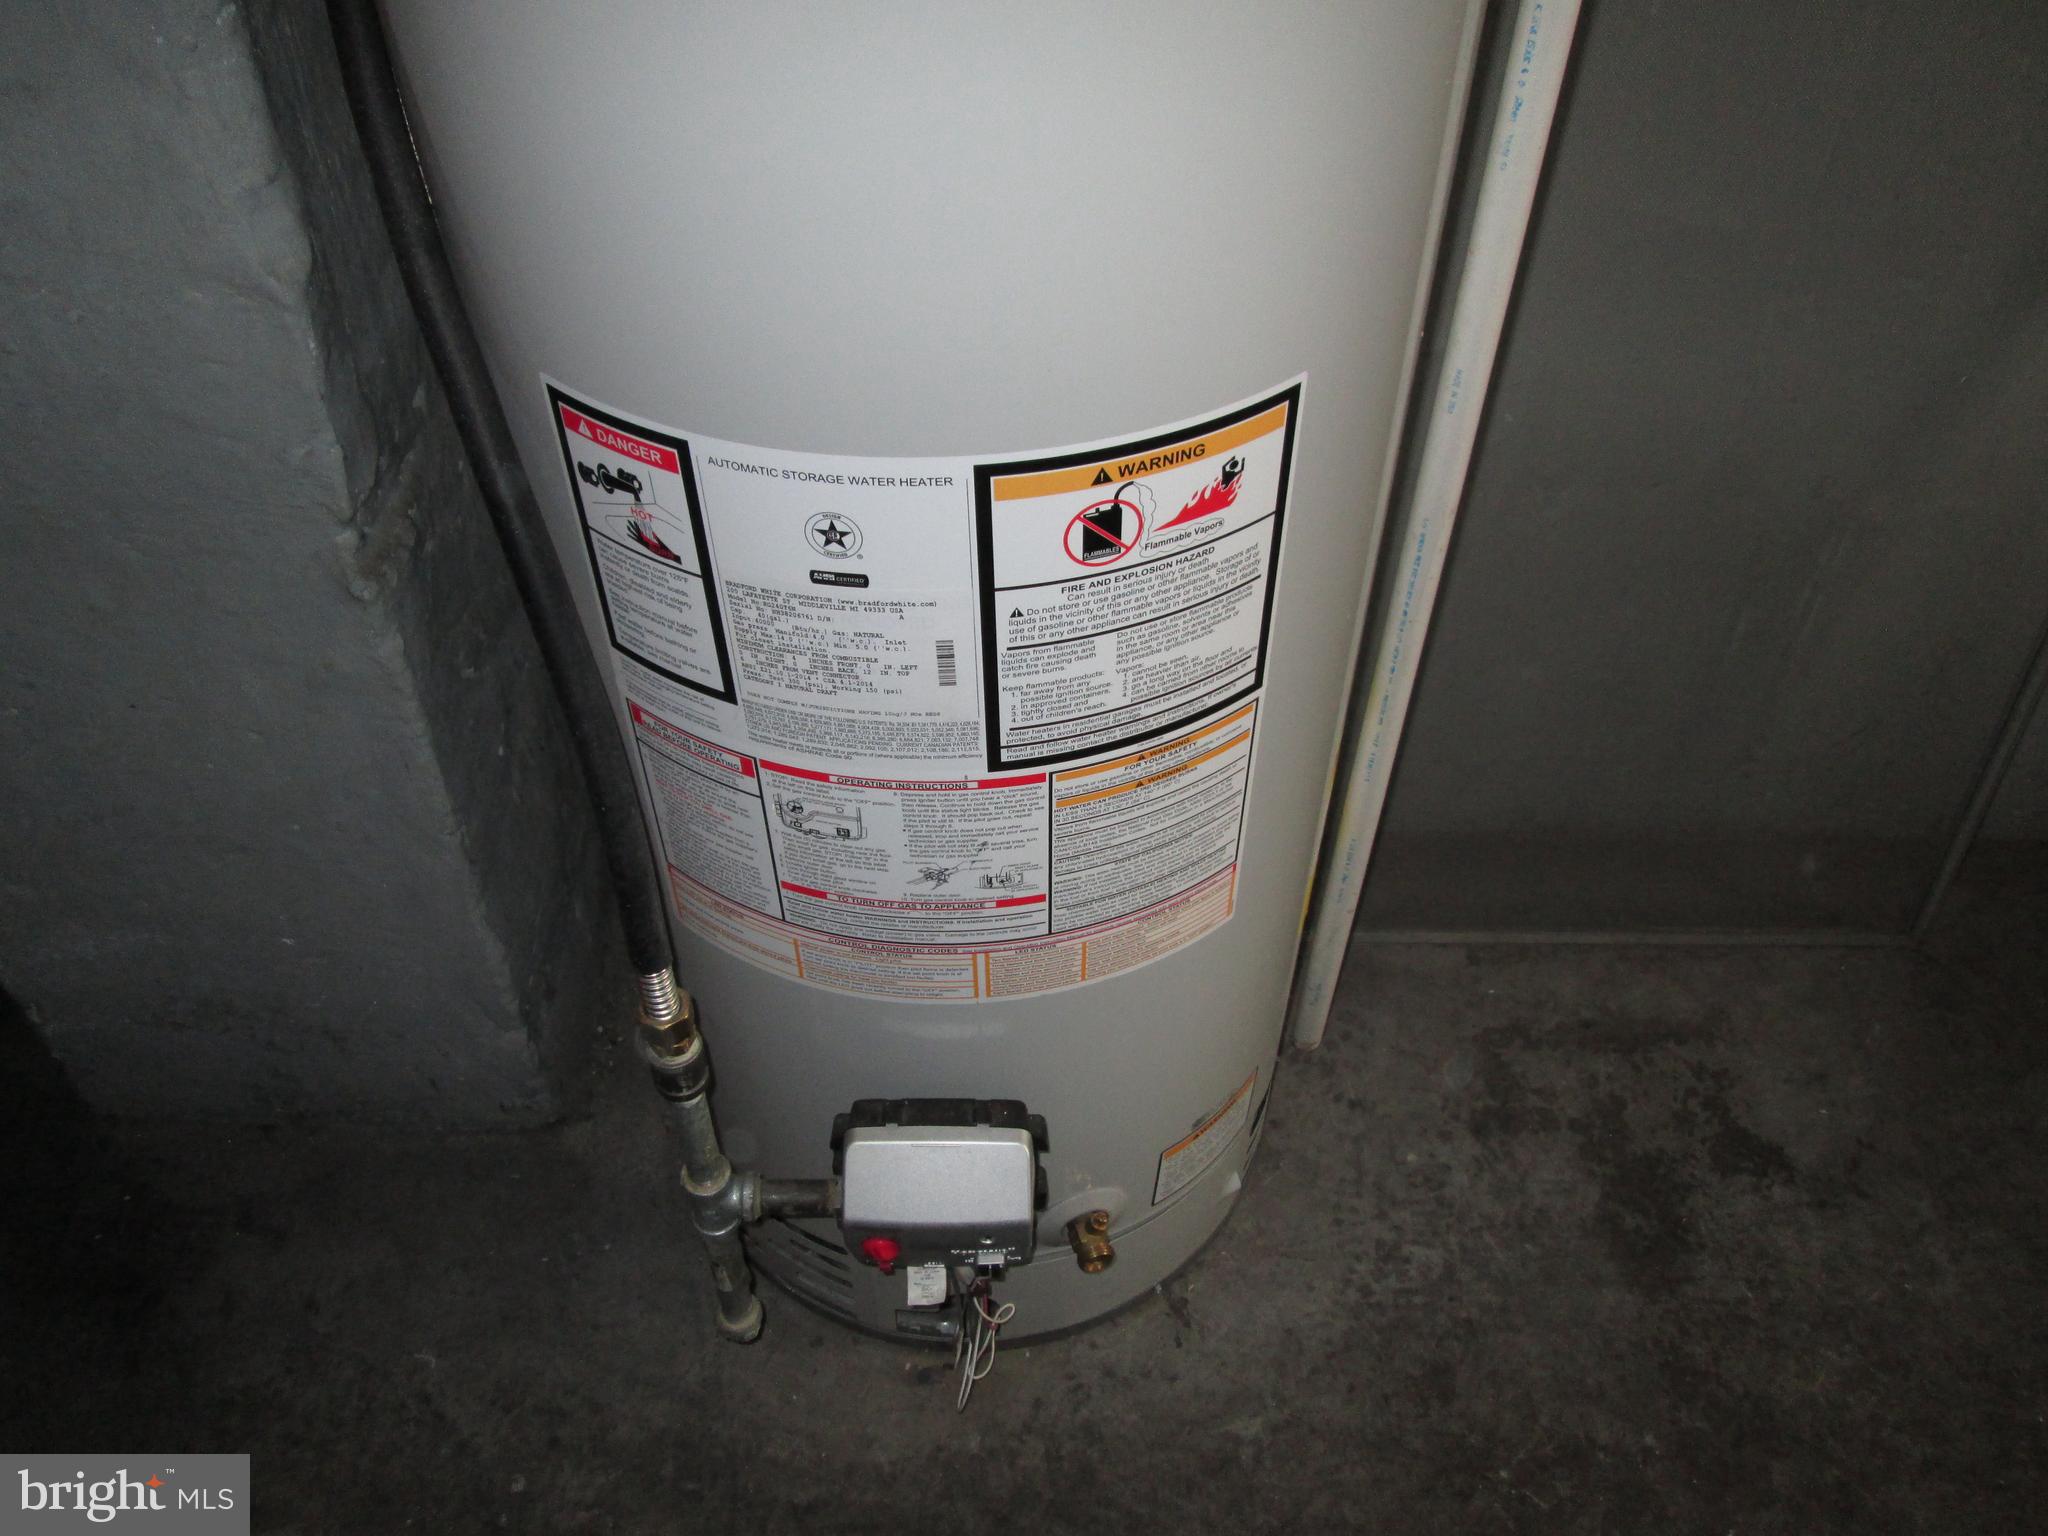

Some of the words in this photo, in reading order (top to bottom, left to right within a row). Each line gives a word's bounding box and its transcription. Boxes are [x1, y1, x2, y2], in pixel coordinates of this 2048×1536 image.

[596, 430, 662, 464] DANGER
[708, 456, 778, 478] AUTOMATIC
[782, 470, 844, 485] STORAGE
[847, 476, 896, 487] WATER
[900, 477, 953, 487] HEATER
[1118, 443, 1206, 478] WARNING
[1144, 530, 1191, 551] Flammable
[1193, 519, 1223, 534] Vapors
[1061, 585, 1085, 594] FIRE
[1088, 579, 1111, 588] AND
[1114, 561, 1174, 583] EXPLOSION
[1176, 547, 1215, 565] HAZARD
[726, 581, 756, 592] BRADFORD
[760, 588, 781, 596] WHITE
[786, 592, 832, 603] CORPORATION
[1041, 606, 1056, 614] not
[1058, 602, 1079, 611] store
[1111, 589, 1144, 602] gasoline
[1158, 577, 1179, 587] other
[1180, 561, 1218, 581] flammable
[1067, 593, 1085, 601] Can
[1087, 588, 1111, 598] result
[1123, 576, 1152, 590] serious
[1154, 569, 1175, 583] injury
[1009, 616, 1036, 627] liquids
[1049, 612, 1063, 620] the
[1066, 605, 1093, 619] vicinity
[1107, 600, 1121, 609] this
[1134, 596, 1149, 605] any
[1151, 588, 1171, 599] other
[1038, 620, 1073, 634] gasoline
[1087, 612, 1108, 623] other
[1112, 600, 1154, 617] flammable
[1156, 592, 1181, 605] vapors
[1193, 579, 1216, 592] liquids
[1020, 633, 1035, 642] this
[1049, 630, 1064, 639] any
[1067, 624, 1088, 635] other
[1091, 615, 1130, 630] appliance
[1133, 611, 1148, 619] can
[1150, 602, 1171, 614] result
[1001, 650, 1030, 659] Vapors
[1053, 639, 1095, 651] flammable
[1001, 657, 1027, 665] liquids
[1047, 648, 1079, 661] explode
[1001, 664, 1023, 672] catch
[1041, 657, 1072, 668] causing
[1013, 670, 1040, 678] severe
[1003, 685, 1023, 694] Keep
[1026, 679, 1067, 690] flammable
[1150, 738, 1190, 756] WARNING
[836, 776, 892, 789] OPERATING
[1147, 764, 1188, 783] WARNING
[851, 897, 875, 907] TURN
